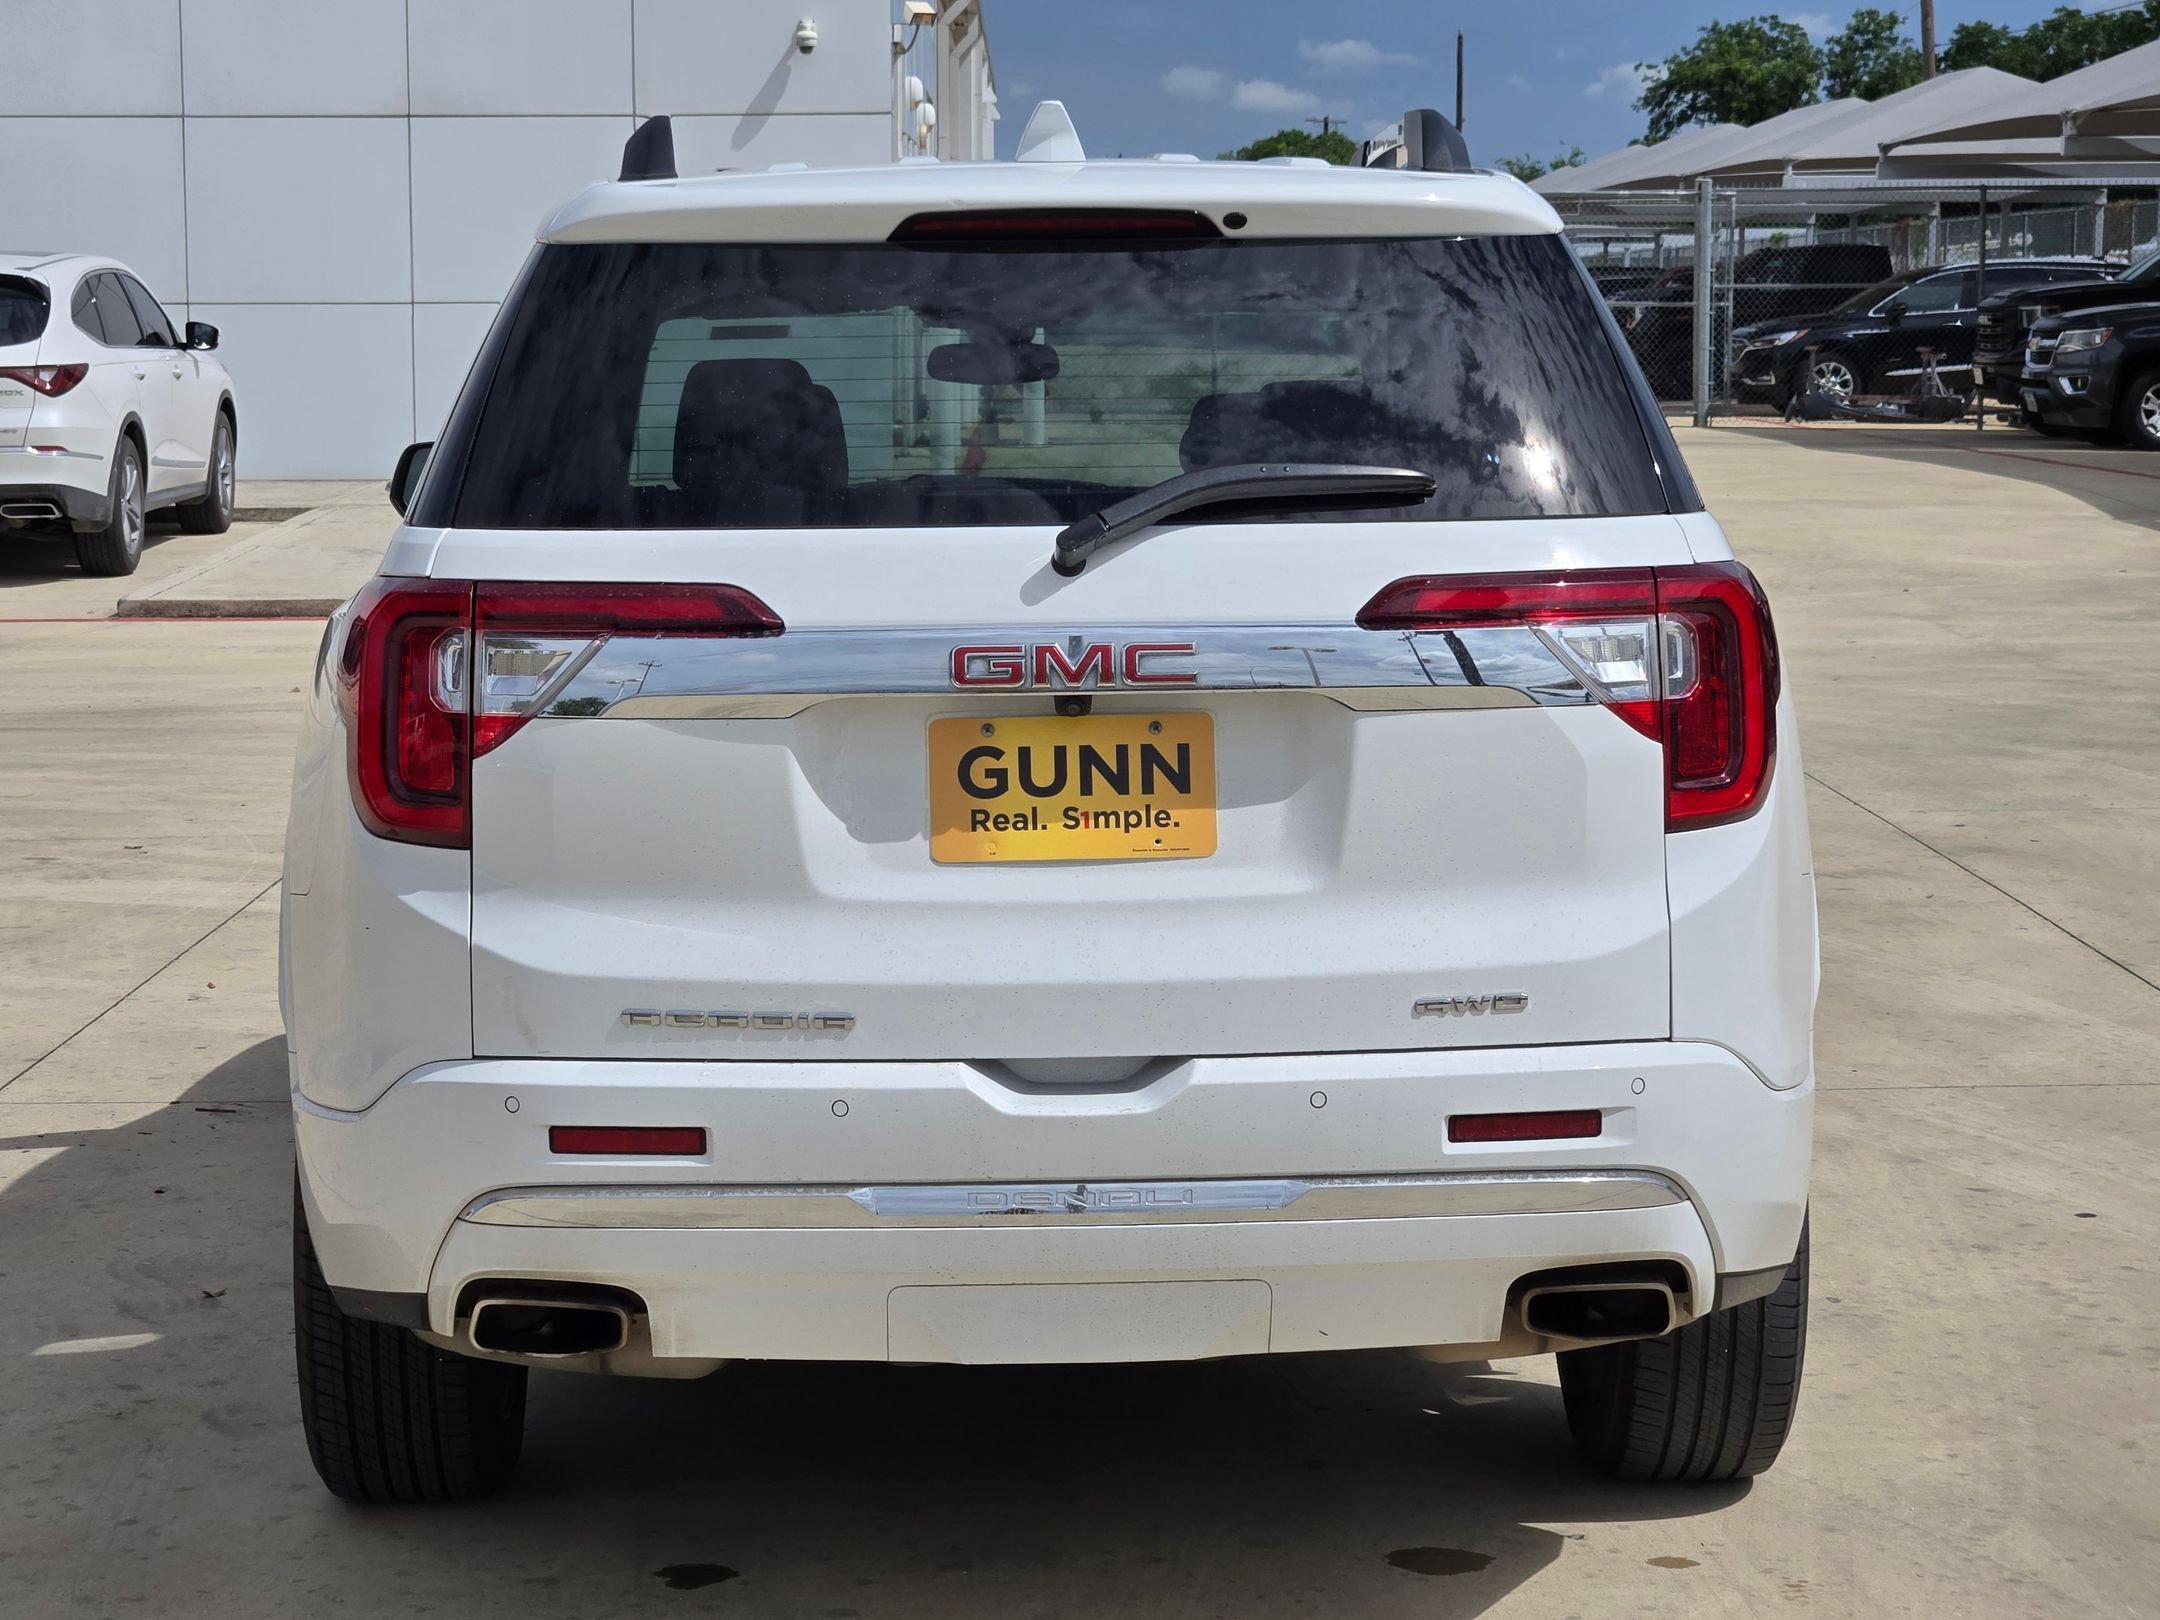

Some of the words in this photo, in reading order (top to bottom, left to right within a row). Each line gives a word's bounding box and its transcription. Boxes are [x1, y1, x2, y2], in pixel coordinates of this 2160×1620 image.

[951, 641, 1198, 688] GMC
[957, 743, 1191, 799] GUNN
[970, 806, 1048, 832] Real.
[1415, 992, 1528, 1014] AWD
[621, 1008, 856, 1030] ACADIA
[967, 1188, 1193, 1208] DENALI
